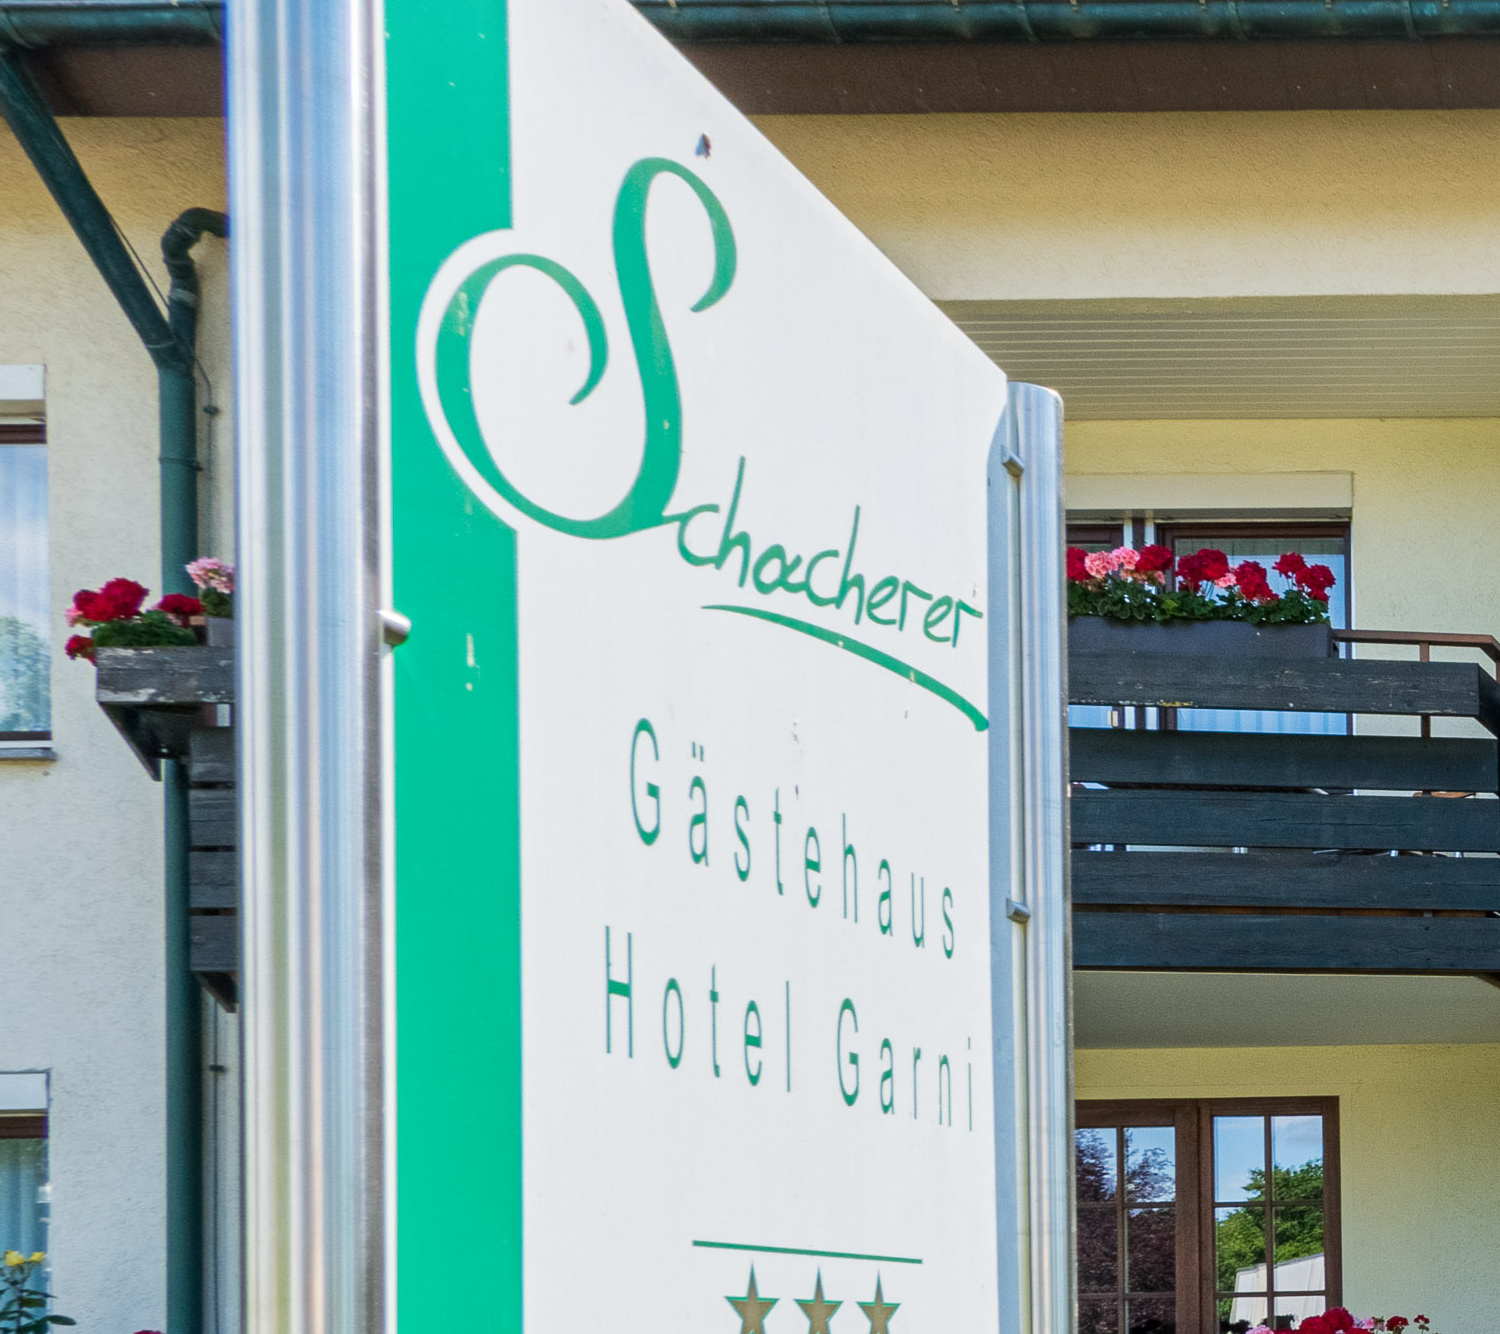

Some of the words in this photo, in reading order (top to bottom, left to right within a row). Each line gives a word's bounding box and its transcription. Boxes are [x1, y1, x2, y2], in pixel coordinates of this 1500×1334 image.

[435, 156, 984, 649] Schacherer
[630, 717, 954, 959] Gästehaus
[604, 924, 791, 1093] Hotel
[836, 997, 973, 1132] Garni
